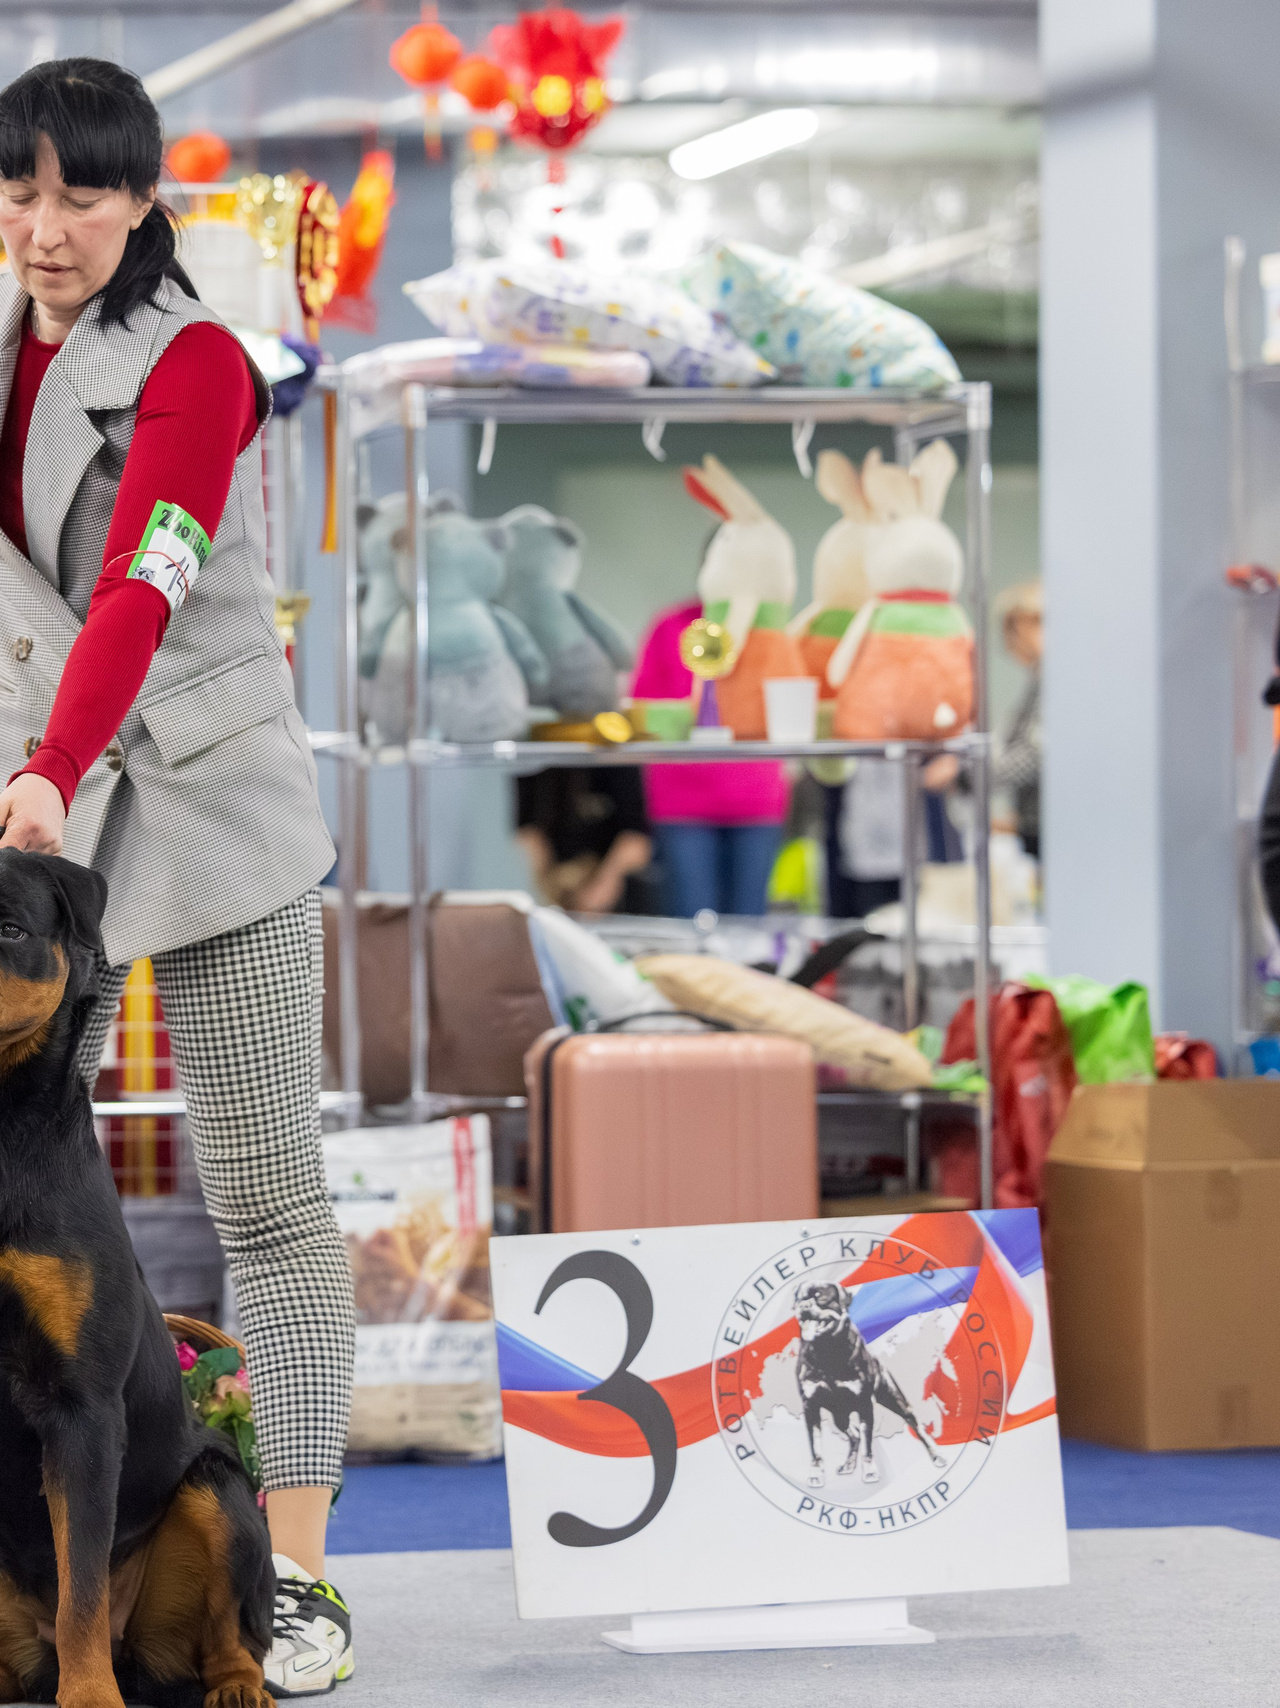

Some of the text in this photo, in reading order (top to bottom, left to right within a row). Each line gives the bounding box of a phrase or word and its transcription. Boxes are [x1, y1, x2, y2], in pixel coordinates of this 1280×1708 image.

[533, 1249, 678, 1548] 3
[718, 1237, 1002, 1461] РОТВЕЙЛЕР КЛУБ РОССИИ
[796, 1480, 950, 1531] РКФ-НКПР
